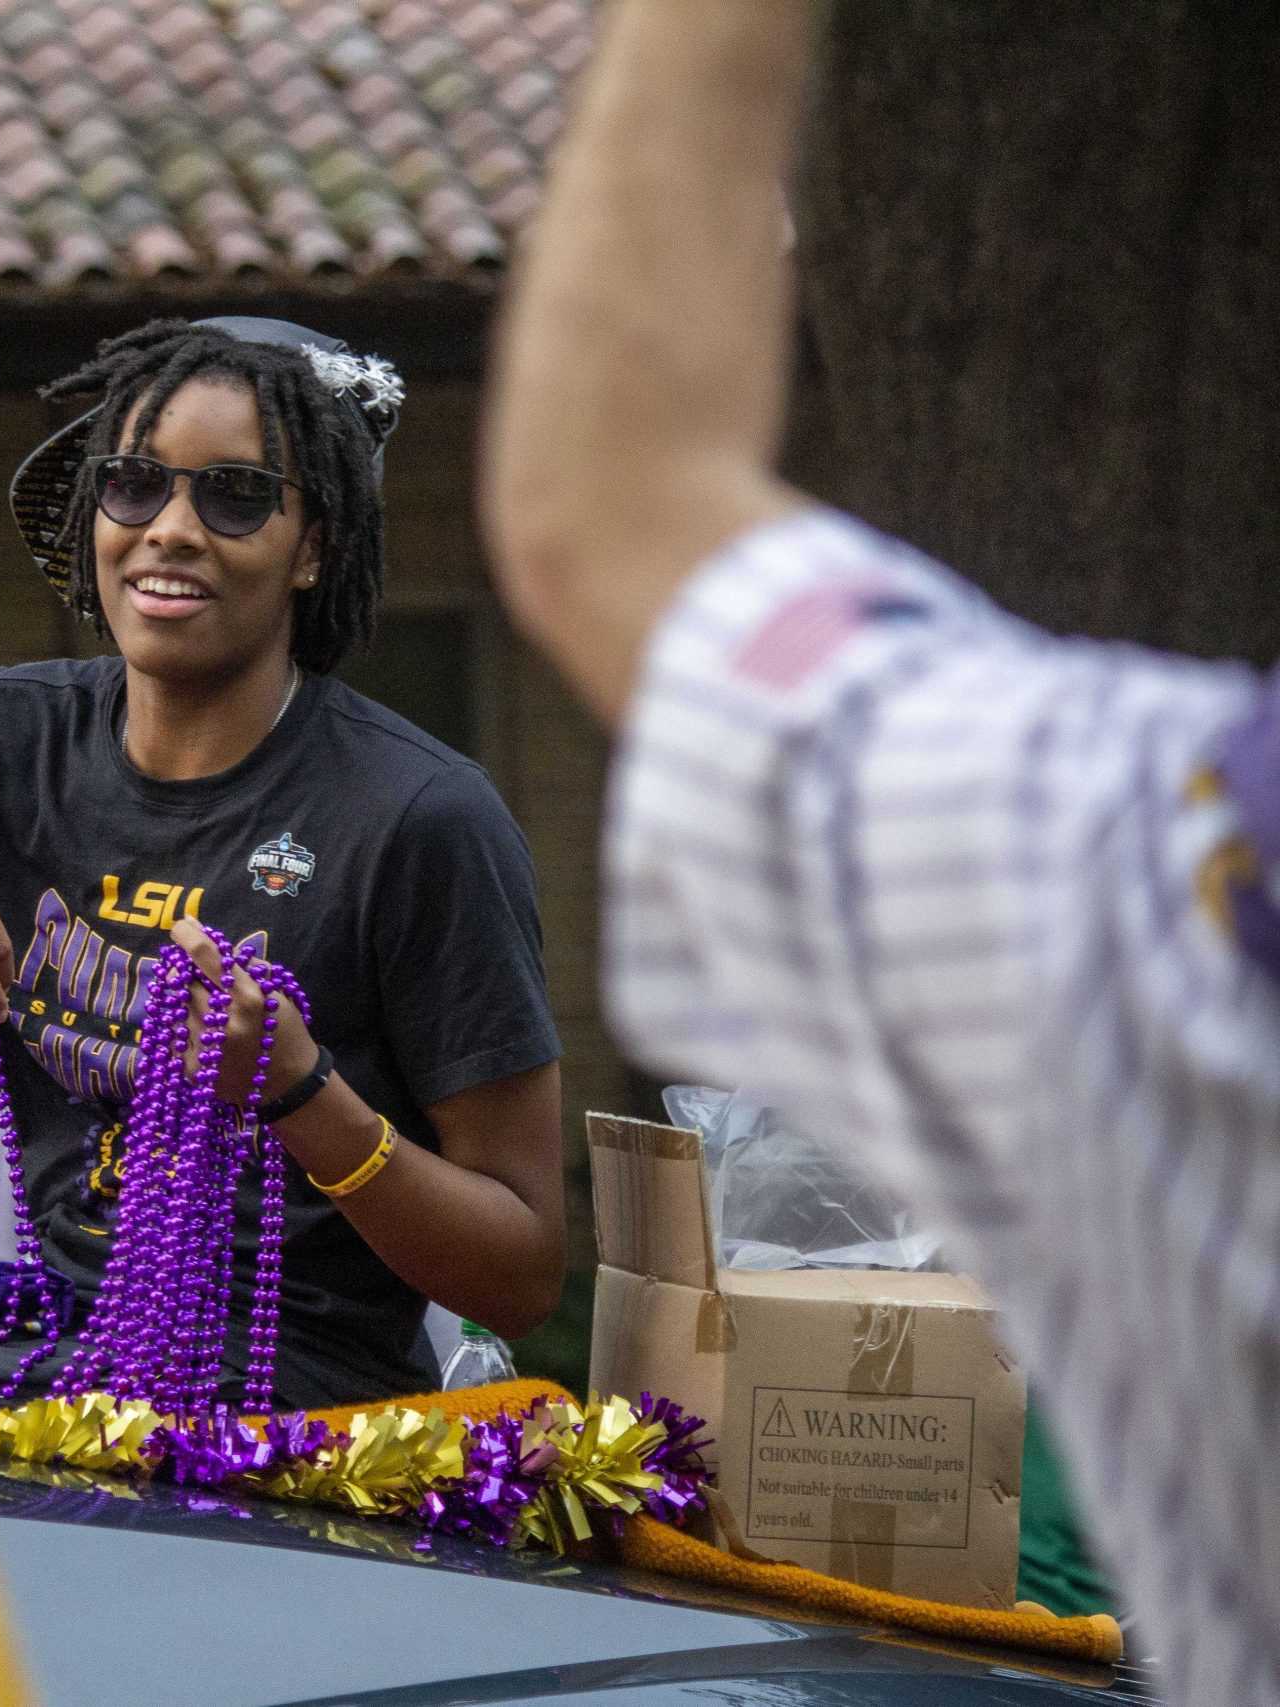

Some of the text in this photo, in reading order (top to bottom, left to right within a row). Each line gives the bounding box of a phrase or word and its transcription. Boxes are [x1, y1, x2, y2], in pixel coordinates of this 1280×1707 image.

[250, 853, 311, 877] FINAL FOUR
[99, 874, 204, 930] LSU
[803, 1409, 948, 1443] WARNING:
[758, 1446, 829, 1466] CHOKING
[935, 1456, 965, 1475] parts
[757, 1478, 958, 1502] Not suitable for children under 14
[755, 1511, 815, 1529] years old.
